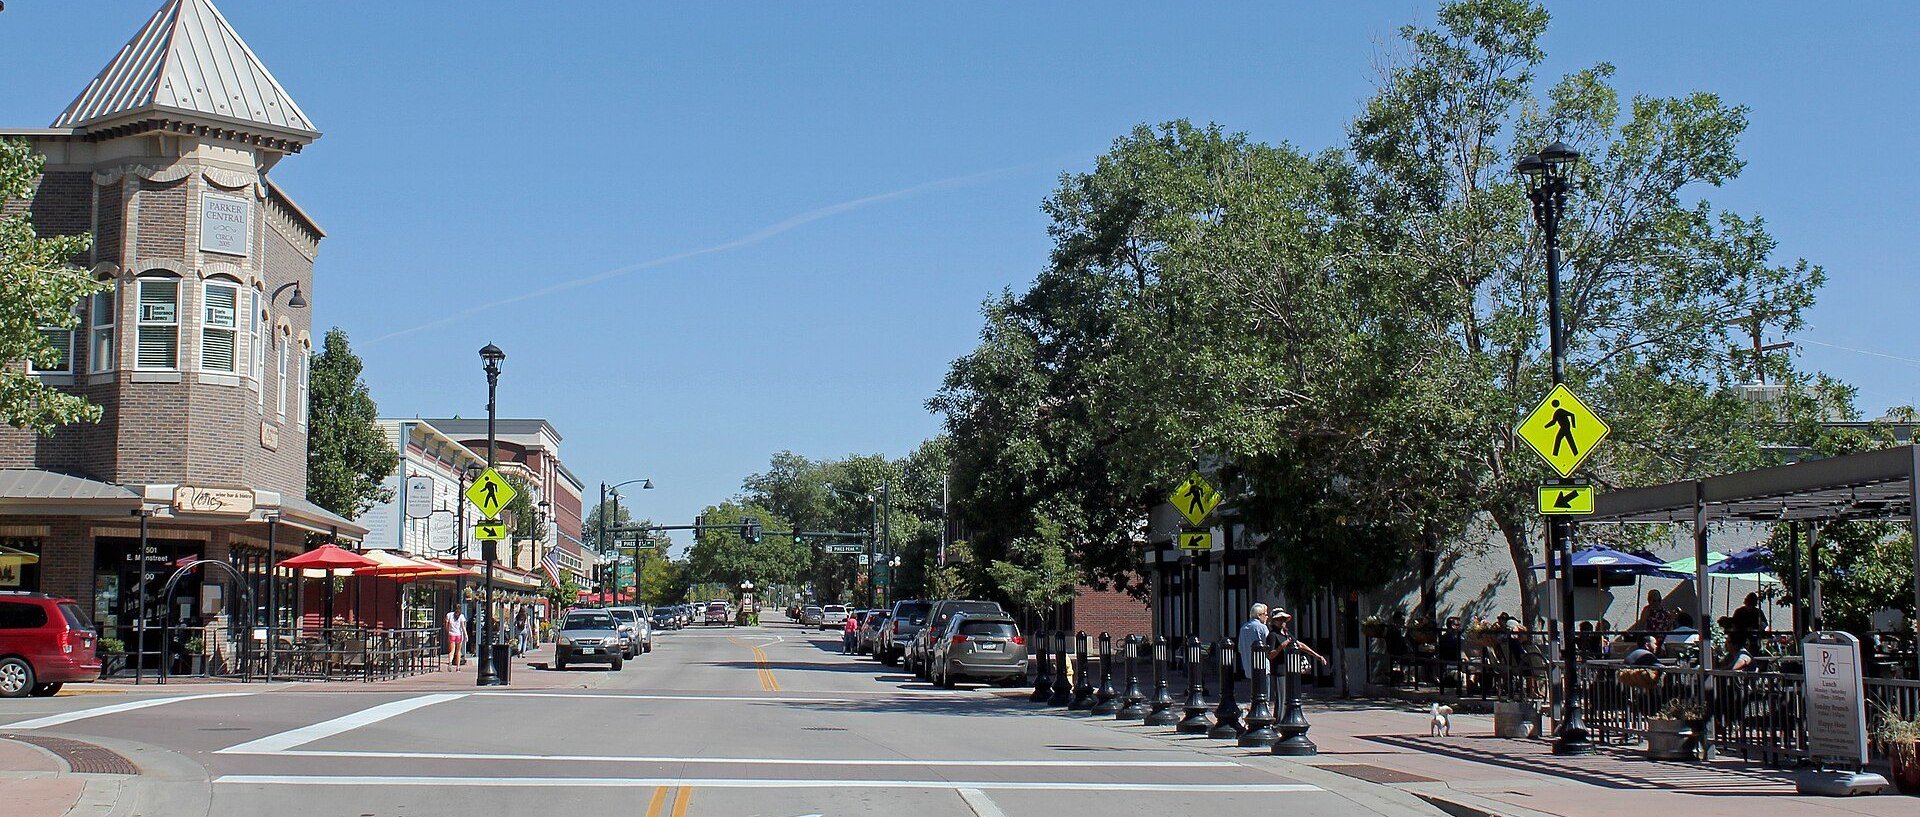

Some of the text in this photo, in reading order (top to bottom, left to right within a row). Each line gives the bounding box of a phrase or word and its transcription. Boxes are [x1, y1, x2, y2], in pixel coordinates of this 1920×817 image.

[210, 202, 242, 214] PARKER
[206, 211, 244, 223] CENTRAL
[215, 233, 234, 241] CIRCA
[135, 554, 168, 562] Mnstreet
